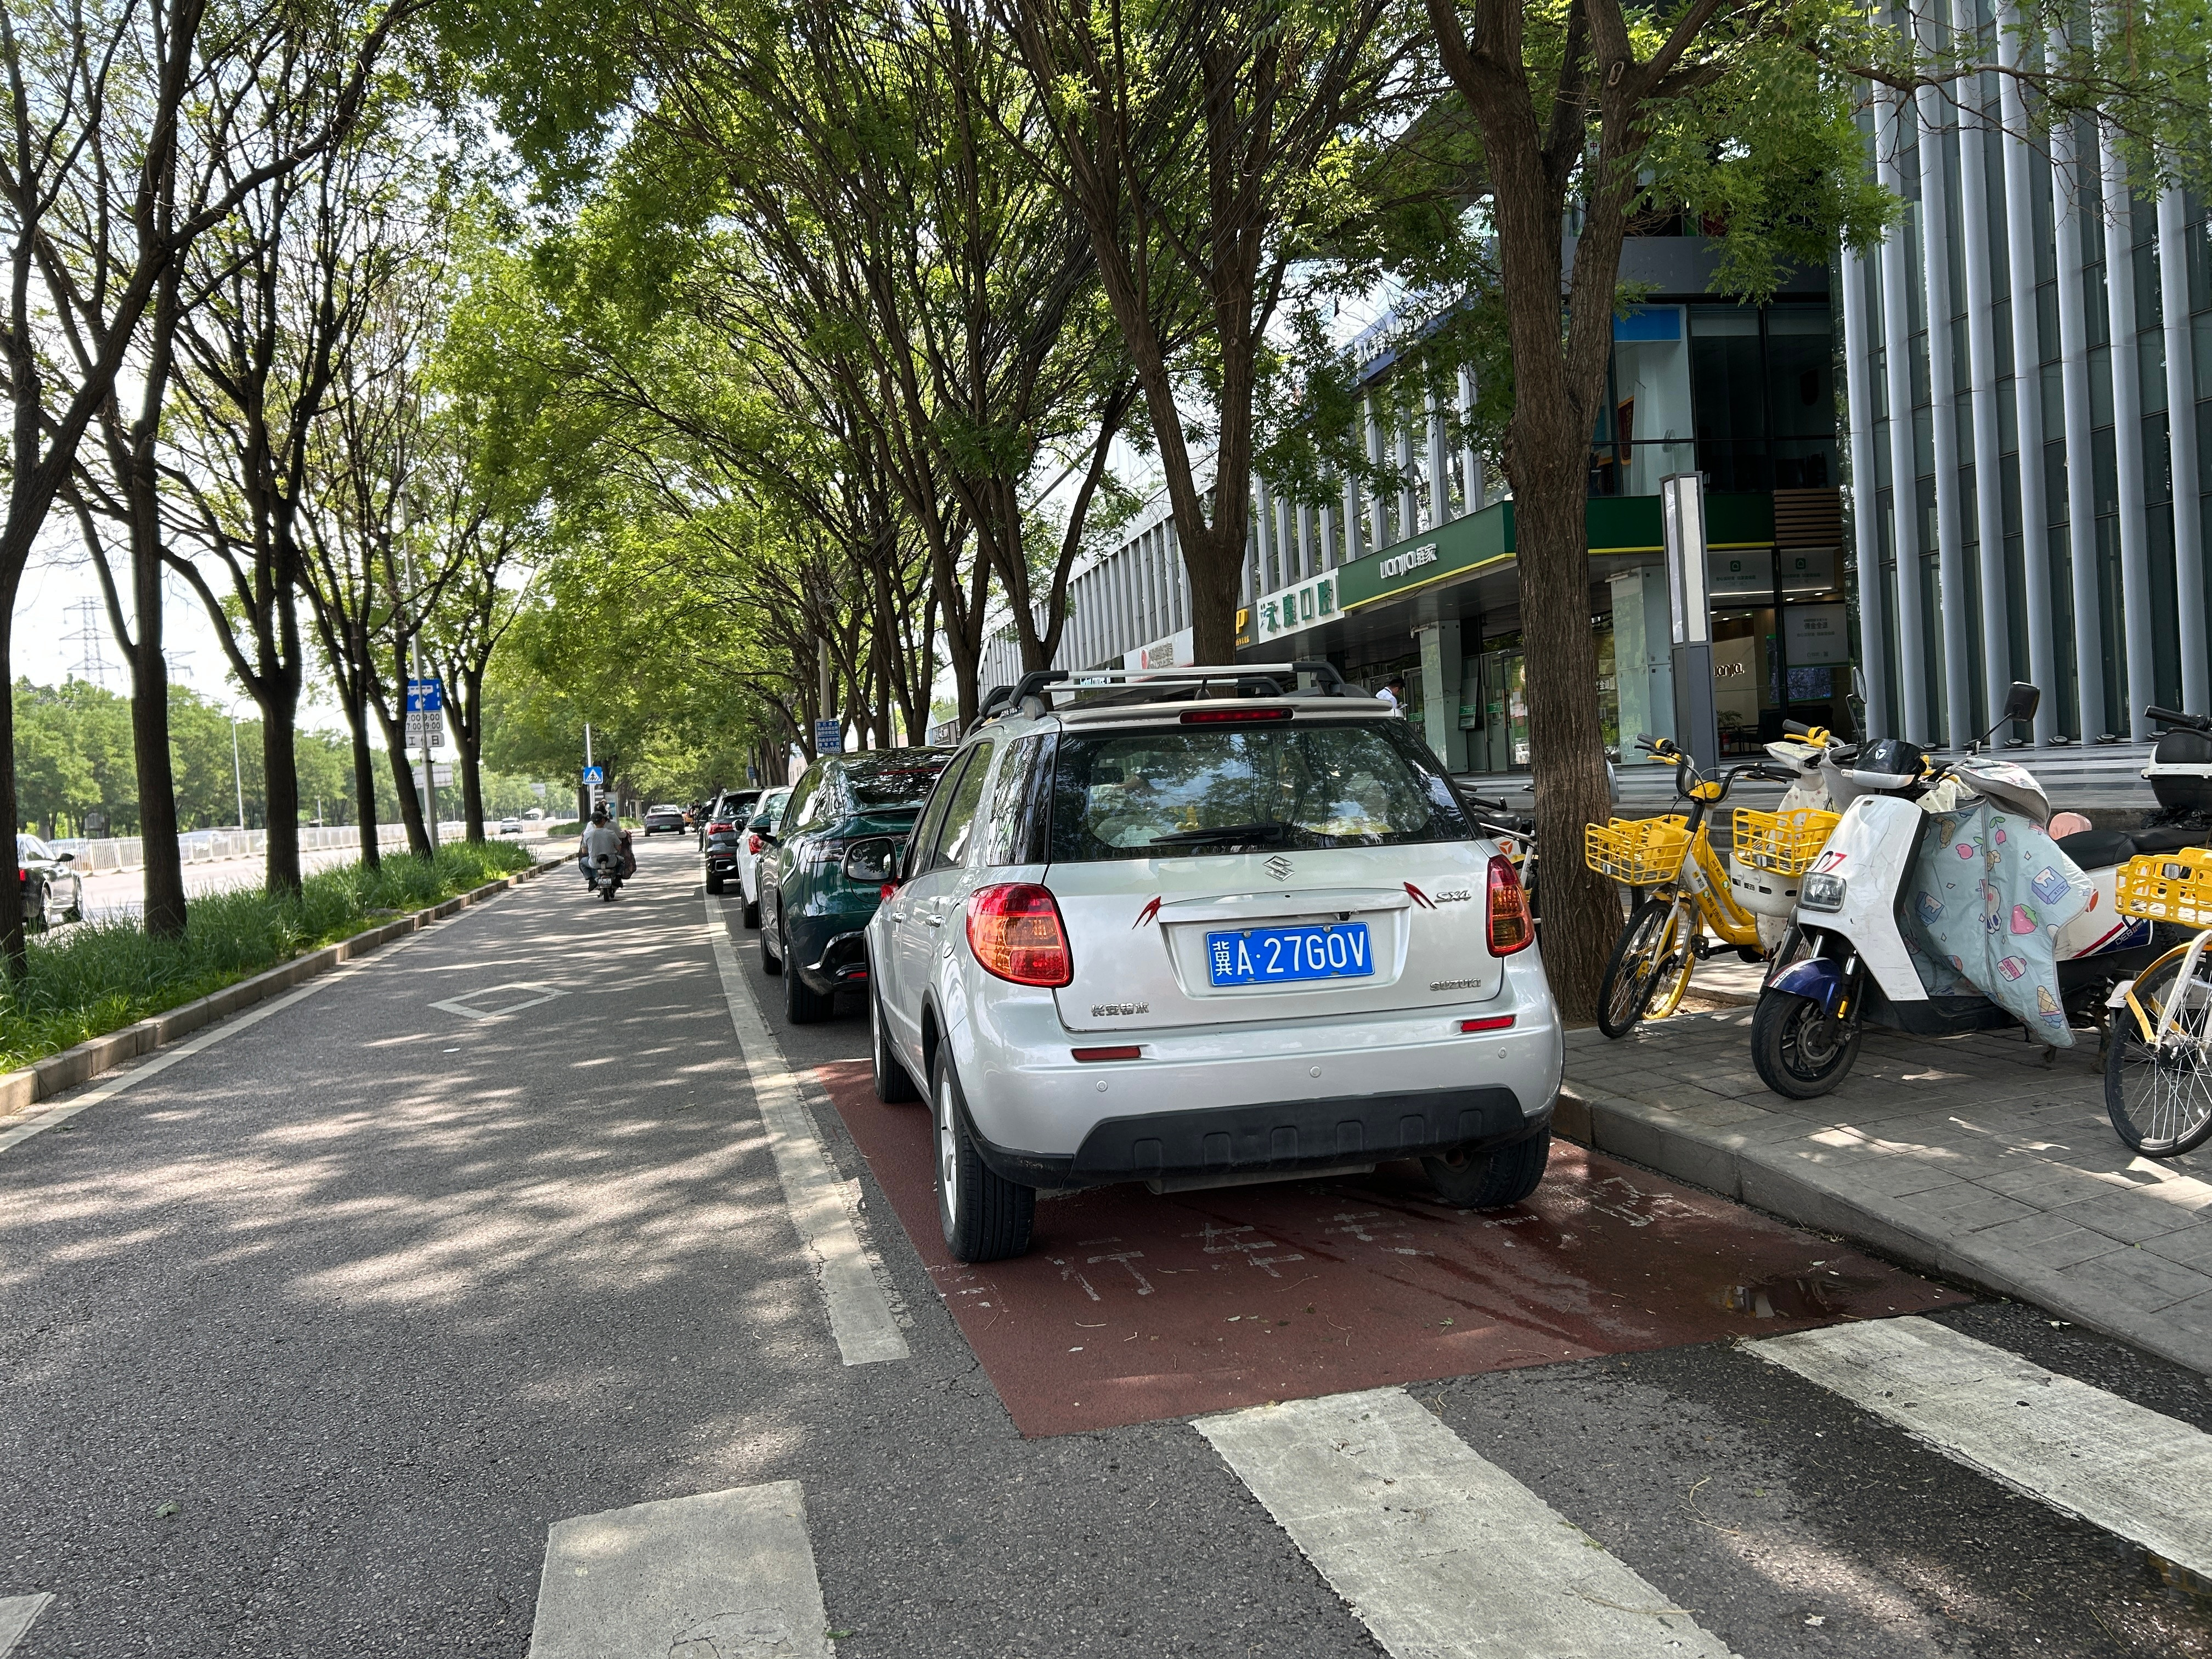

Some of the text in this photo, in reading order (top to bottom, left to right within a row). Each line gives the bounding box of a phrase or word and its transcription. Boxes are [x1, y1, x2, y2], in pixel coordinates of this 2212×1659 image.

[1416, 543, 1437, 566] 链家
[1266, 579, 1334, 633] 永康口腔
[1434, 890, 1472, 903] SX4
[1430, 978, 1481, 991] SUZUKI
[1091, 1002, 1149, 1017] 长安铃木
